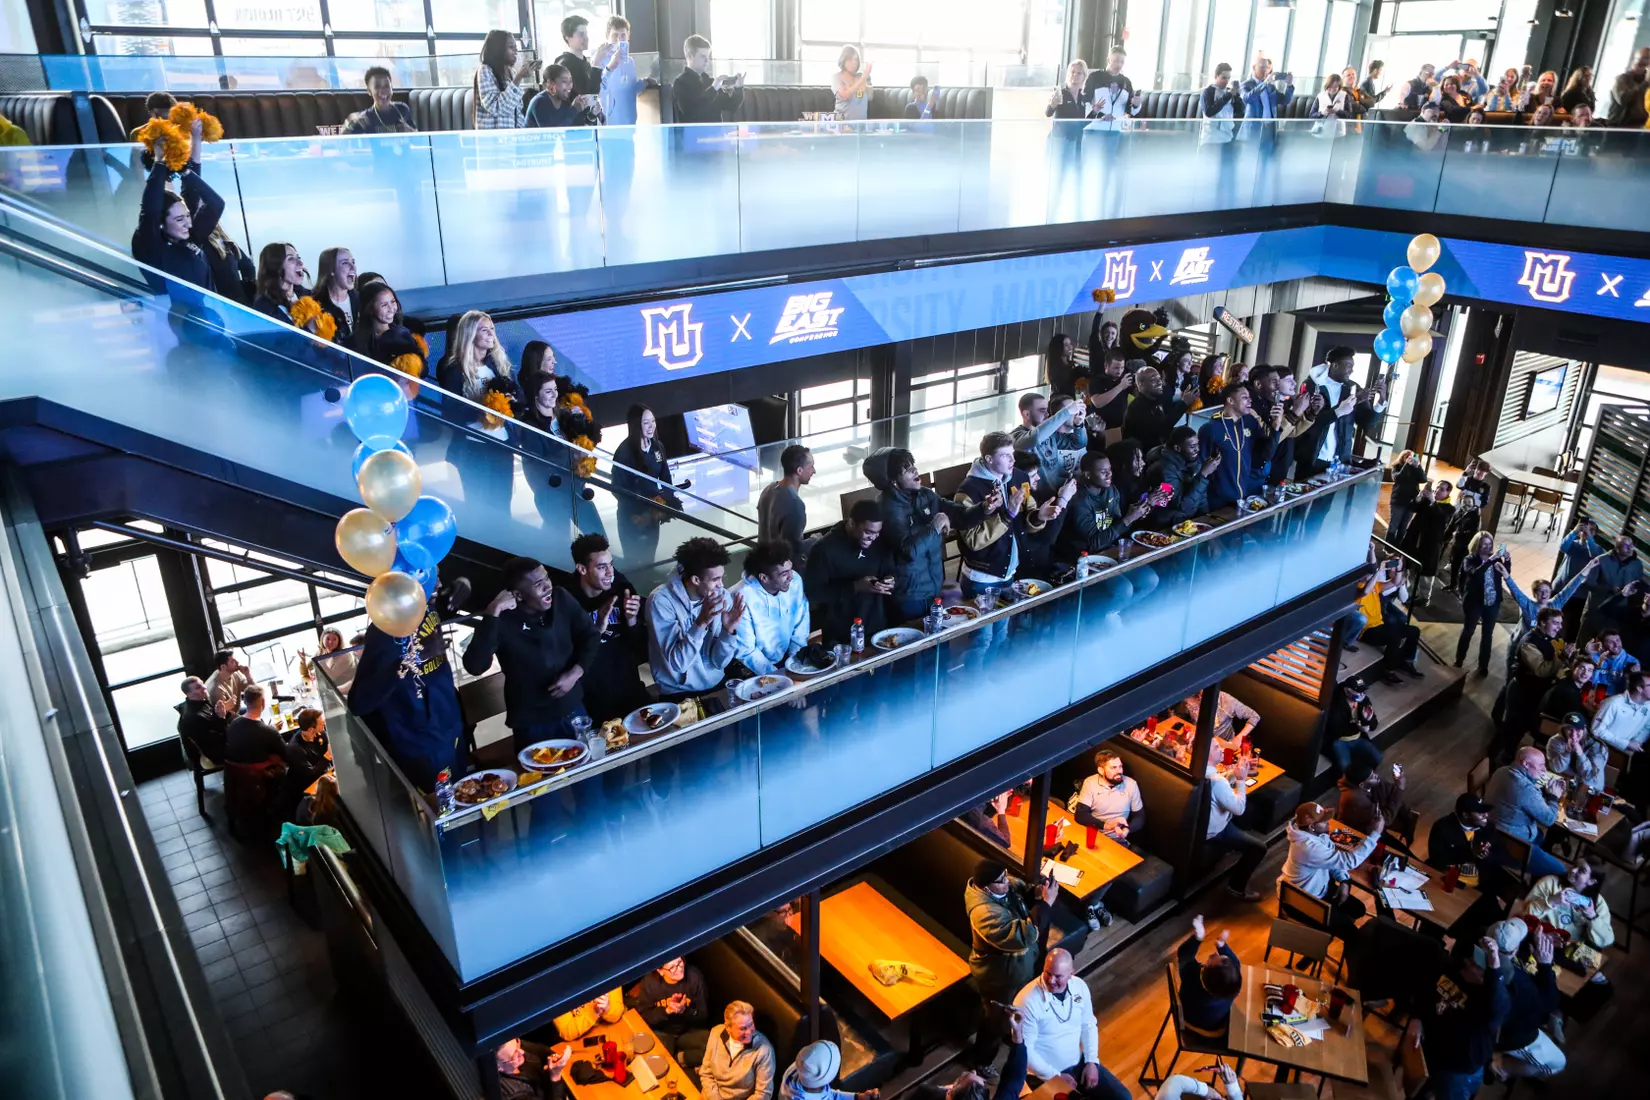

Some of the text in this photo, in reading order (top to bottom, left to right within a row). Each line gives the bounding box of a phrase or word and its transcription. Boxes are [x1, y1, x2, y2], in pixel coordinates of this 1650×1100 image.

[1102, 250, 1138, 300] MU
[1518, 251, 1577, 303] MU
[775, 307, 845, 334] EAST
[782, 291, 834, 317] BIG
[640, 303, 704, 371] MU
[788, 330, 839, 345] CONFERENCE
[1221, 310, 1255, 343] RESTROOMS
